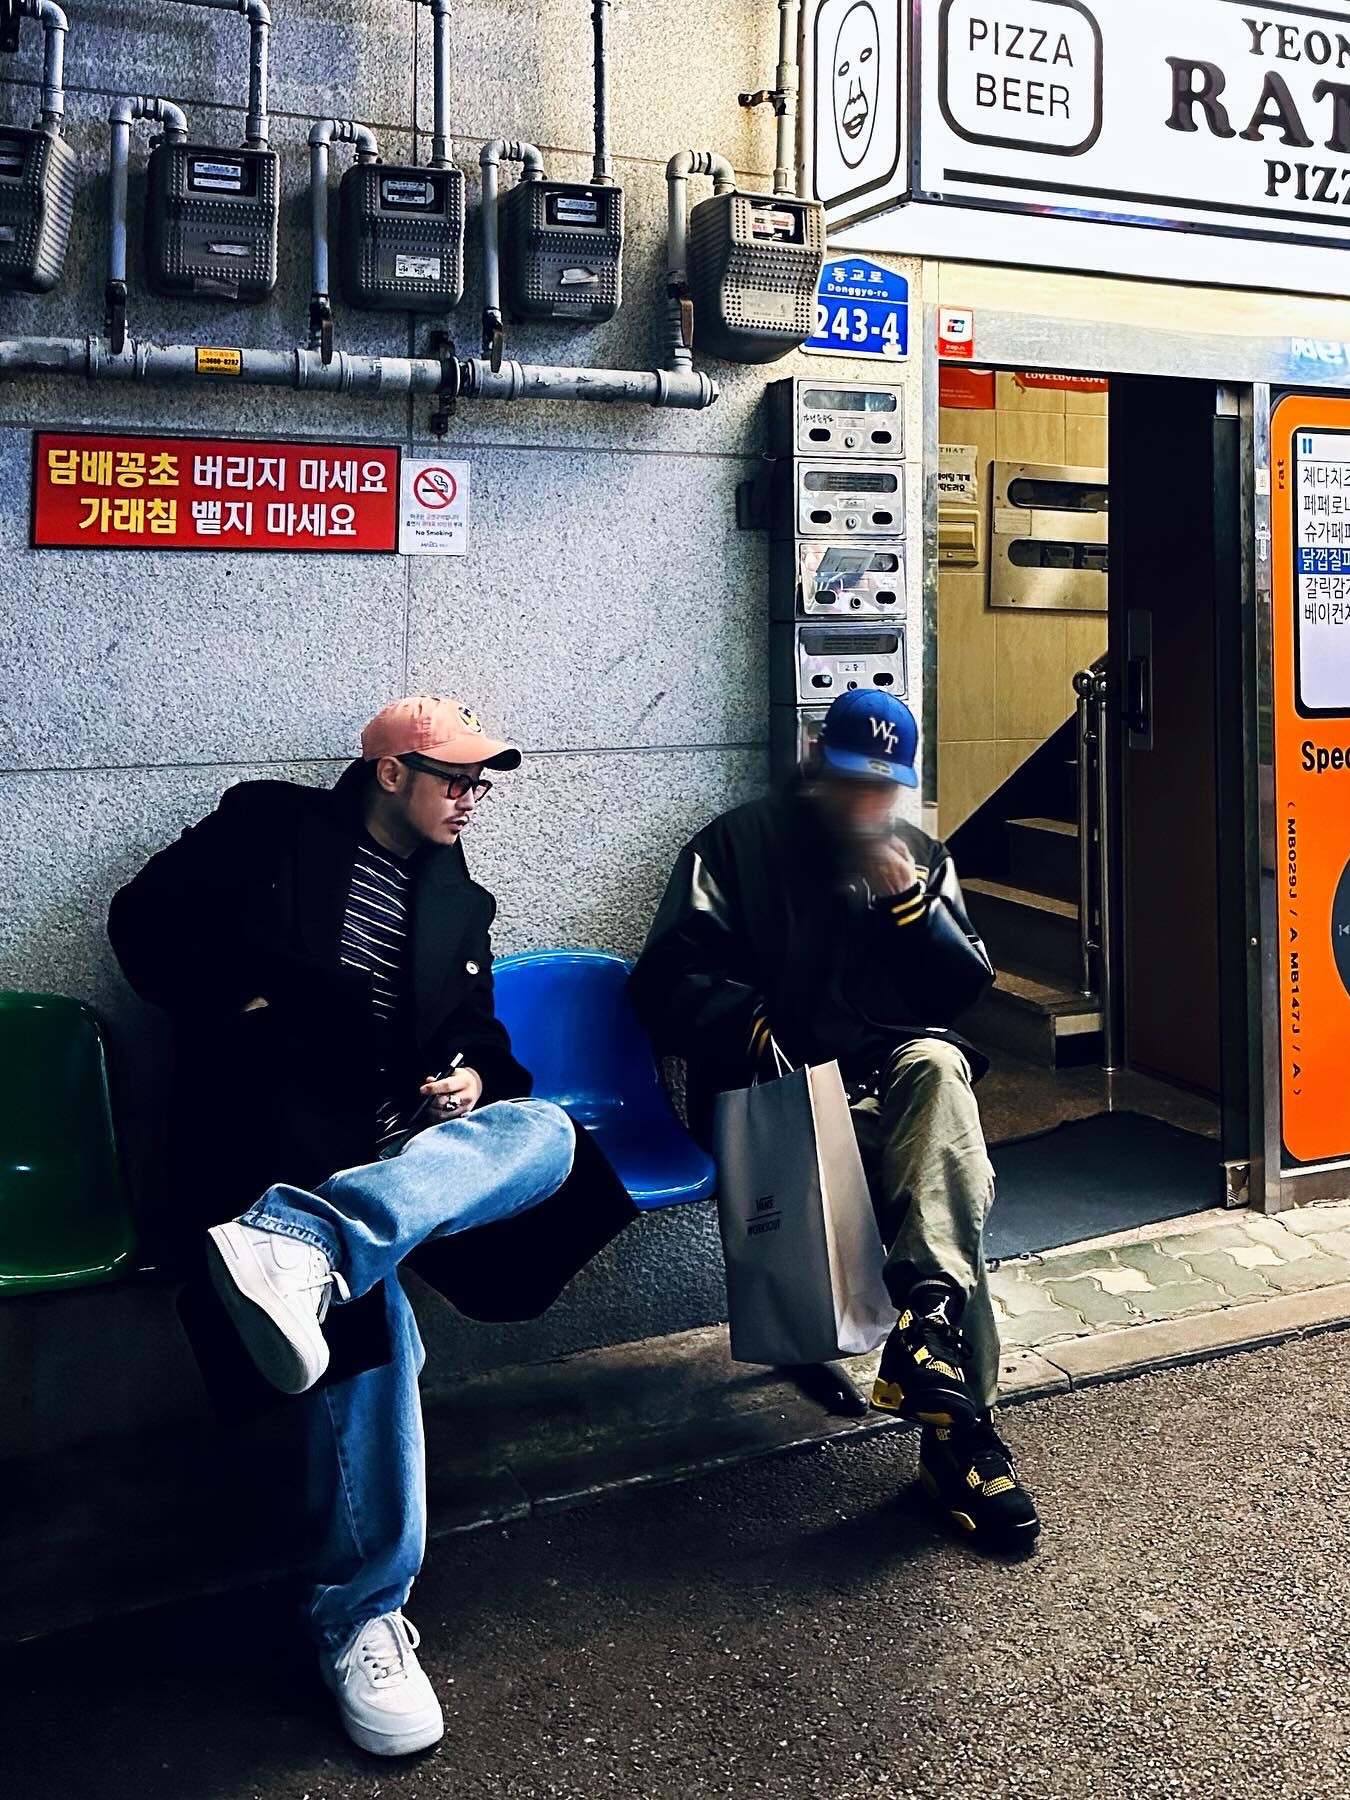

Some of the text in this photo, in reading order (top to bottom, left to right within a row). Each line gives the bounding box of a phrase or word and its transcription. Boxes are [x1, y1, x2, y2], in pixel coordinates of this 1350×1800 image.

[969, 17, 1074, 67] PIZZA
[975, 72, 1070, 119] BEER
[1165, 55, 1350, 154] RAT
[827, 283, 889, 298] Donggyo-ro
[831, 267, 884, 283] 동교로
[813, 304, 900, 346] 243-4
[48, 449, 388, 494] 담배꽁초 버리지 마세요
[1277, 459, 1285, 490] rat
[79, 497, 357, 537] 가래침 뱉지 마세요
[426, 529, 453, 538] Smoking
[869, 717, 899, 754] WT
[1287, 818, 1298, 899] MB029J
[1290, 952, 1301, 1034] MB147J
